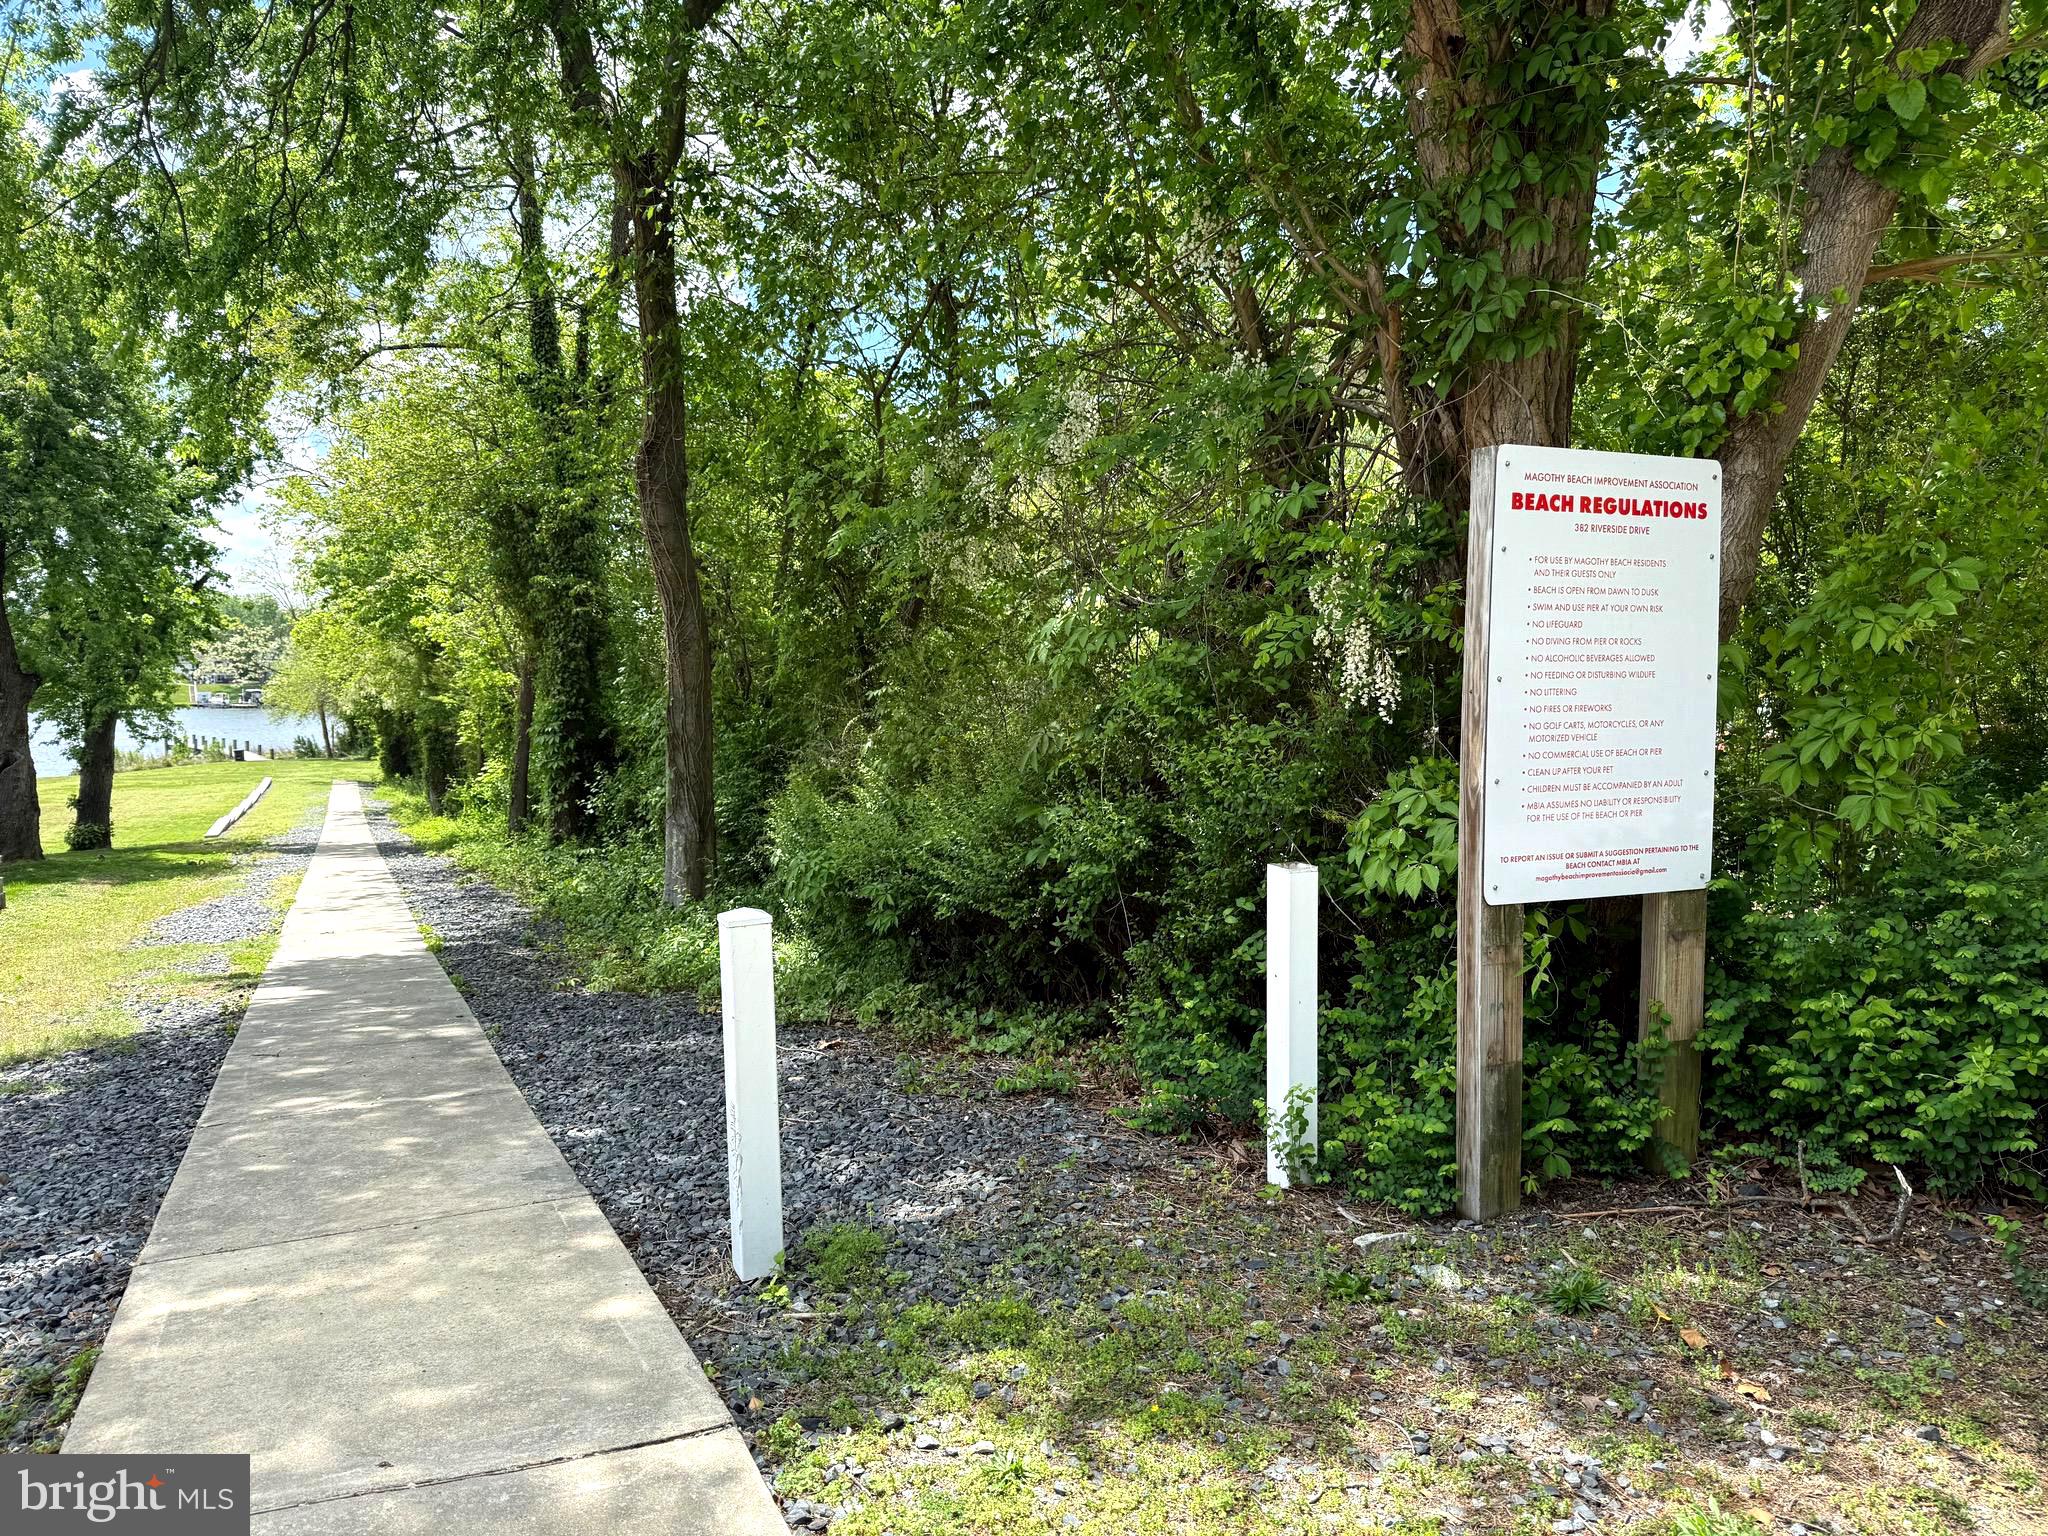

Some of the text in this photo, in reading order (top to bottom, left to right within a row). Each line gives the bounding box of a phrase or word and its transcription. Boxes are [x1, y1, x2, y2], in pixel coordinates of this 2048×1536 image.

[1524, 473, 1698, 491] MAGOTHY BEACH IMPROVEMENT ASSOCIATION
[1512, 493, 1707, 519] BEACH REGULATIONS
[1575, 524, 1650, 534] 382 RIVERSIDE DRIVE
[1588, 721, 1637, 729] MOTORCYCLES,
[1542, 750, 1589, 759] COMMERCIAL
[1527, 784, 1560, 793] CHILDREN
[1592, 781, 1642, 790] ACCOMPANIED
[1546, 800, 1578, 808] ASSUMES
[1594, 798, 1620, 806] LIABILITY
[1633, 796, 1681, 805] RESPONSIBILITY
[1605, 848, 1643, 856] SUGGESTION
